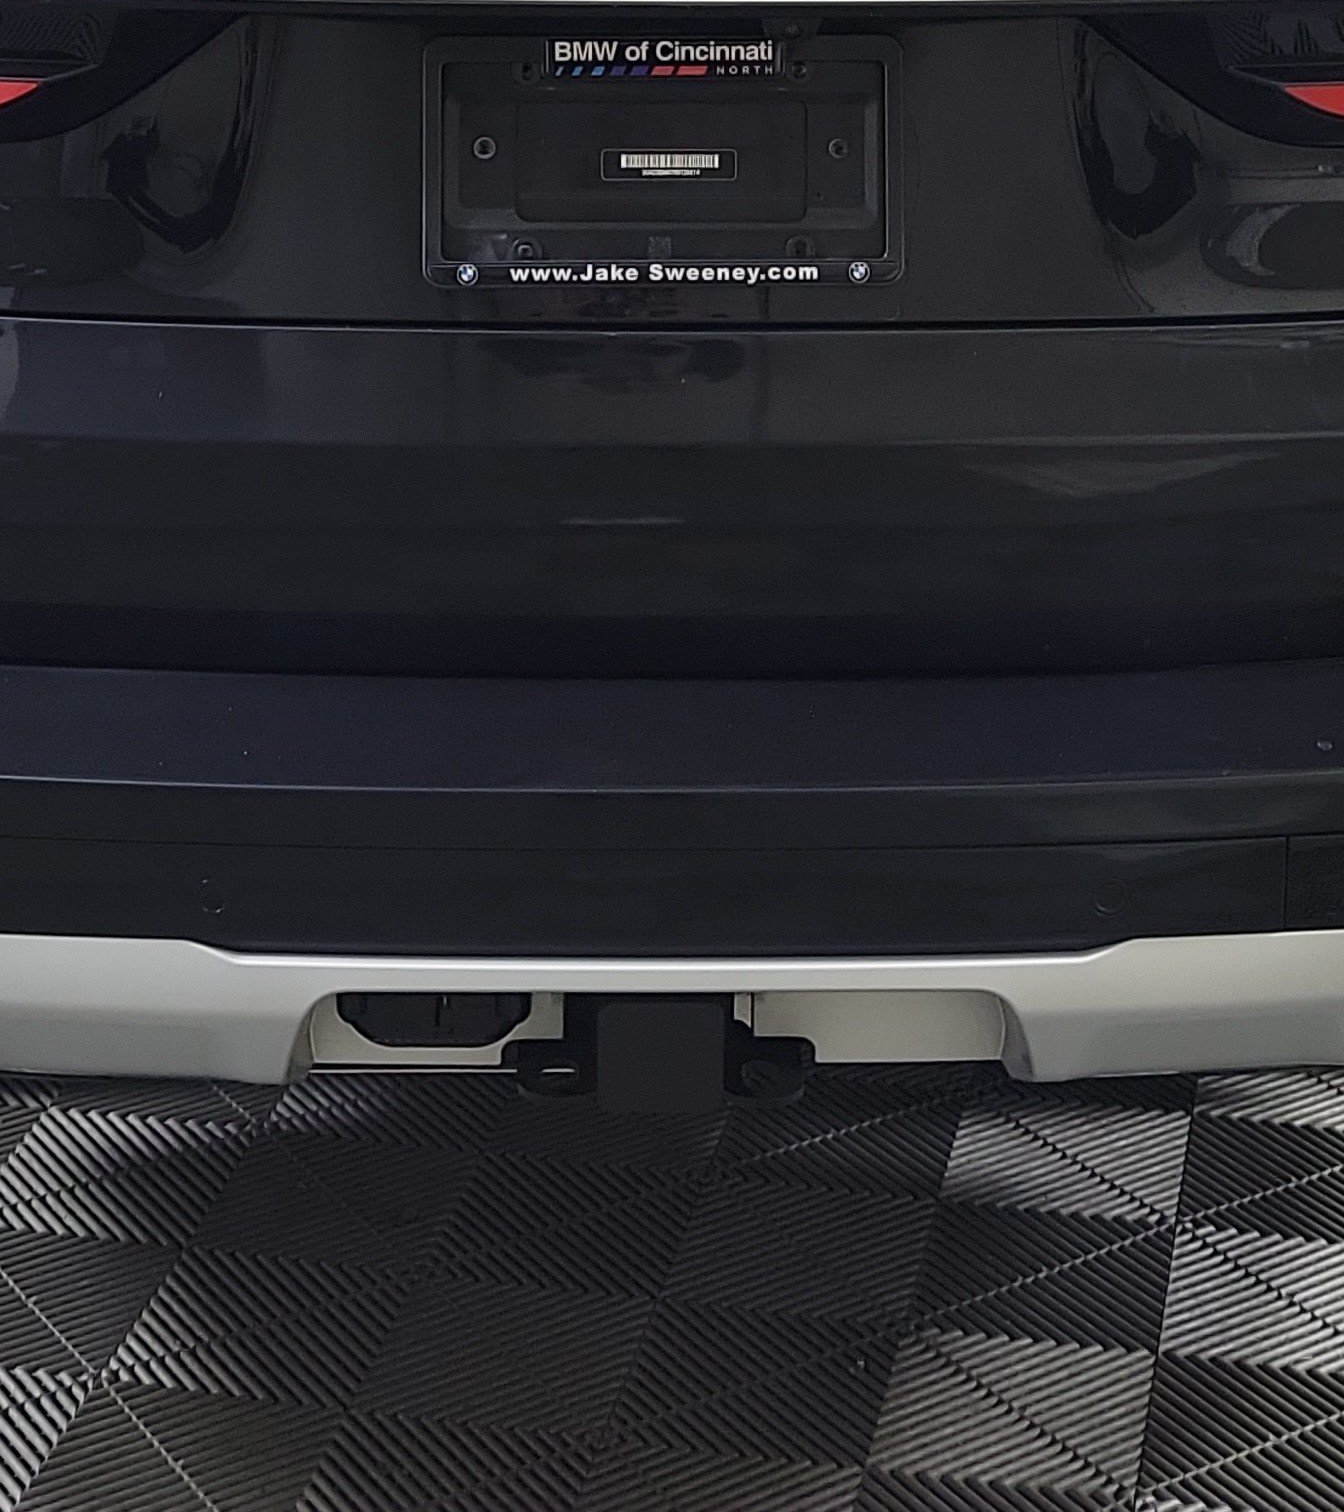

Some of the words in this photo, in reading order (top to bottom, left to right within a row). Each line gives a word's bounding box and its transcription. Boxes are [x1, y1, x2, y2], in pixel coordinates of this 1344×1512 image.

[554, 41, 617, 62] BMW
[624, 40, 649, 62] of
[655, 40, 773, 62] Cincinnati
[716, 66, 774, 76] NORTH
[509, 263, 639, 283] www.Jake
[648, 263, 819, 285] Sweeney.com
